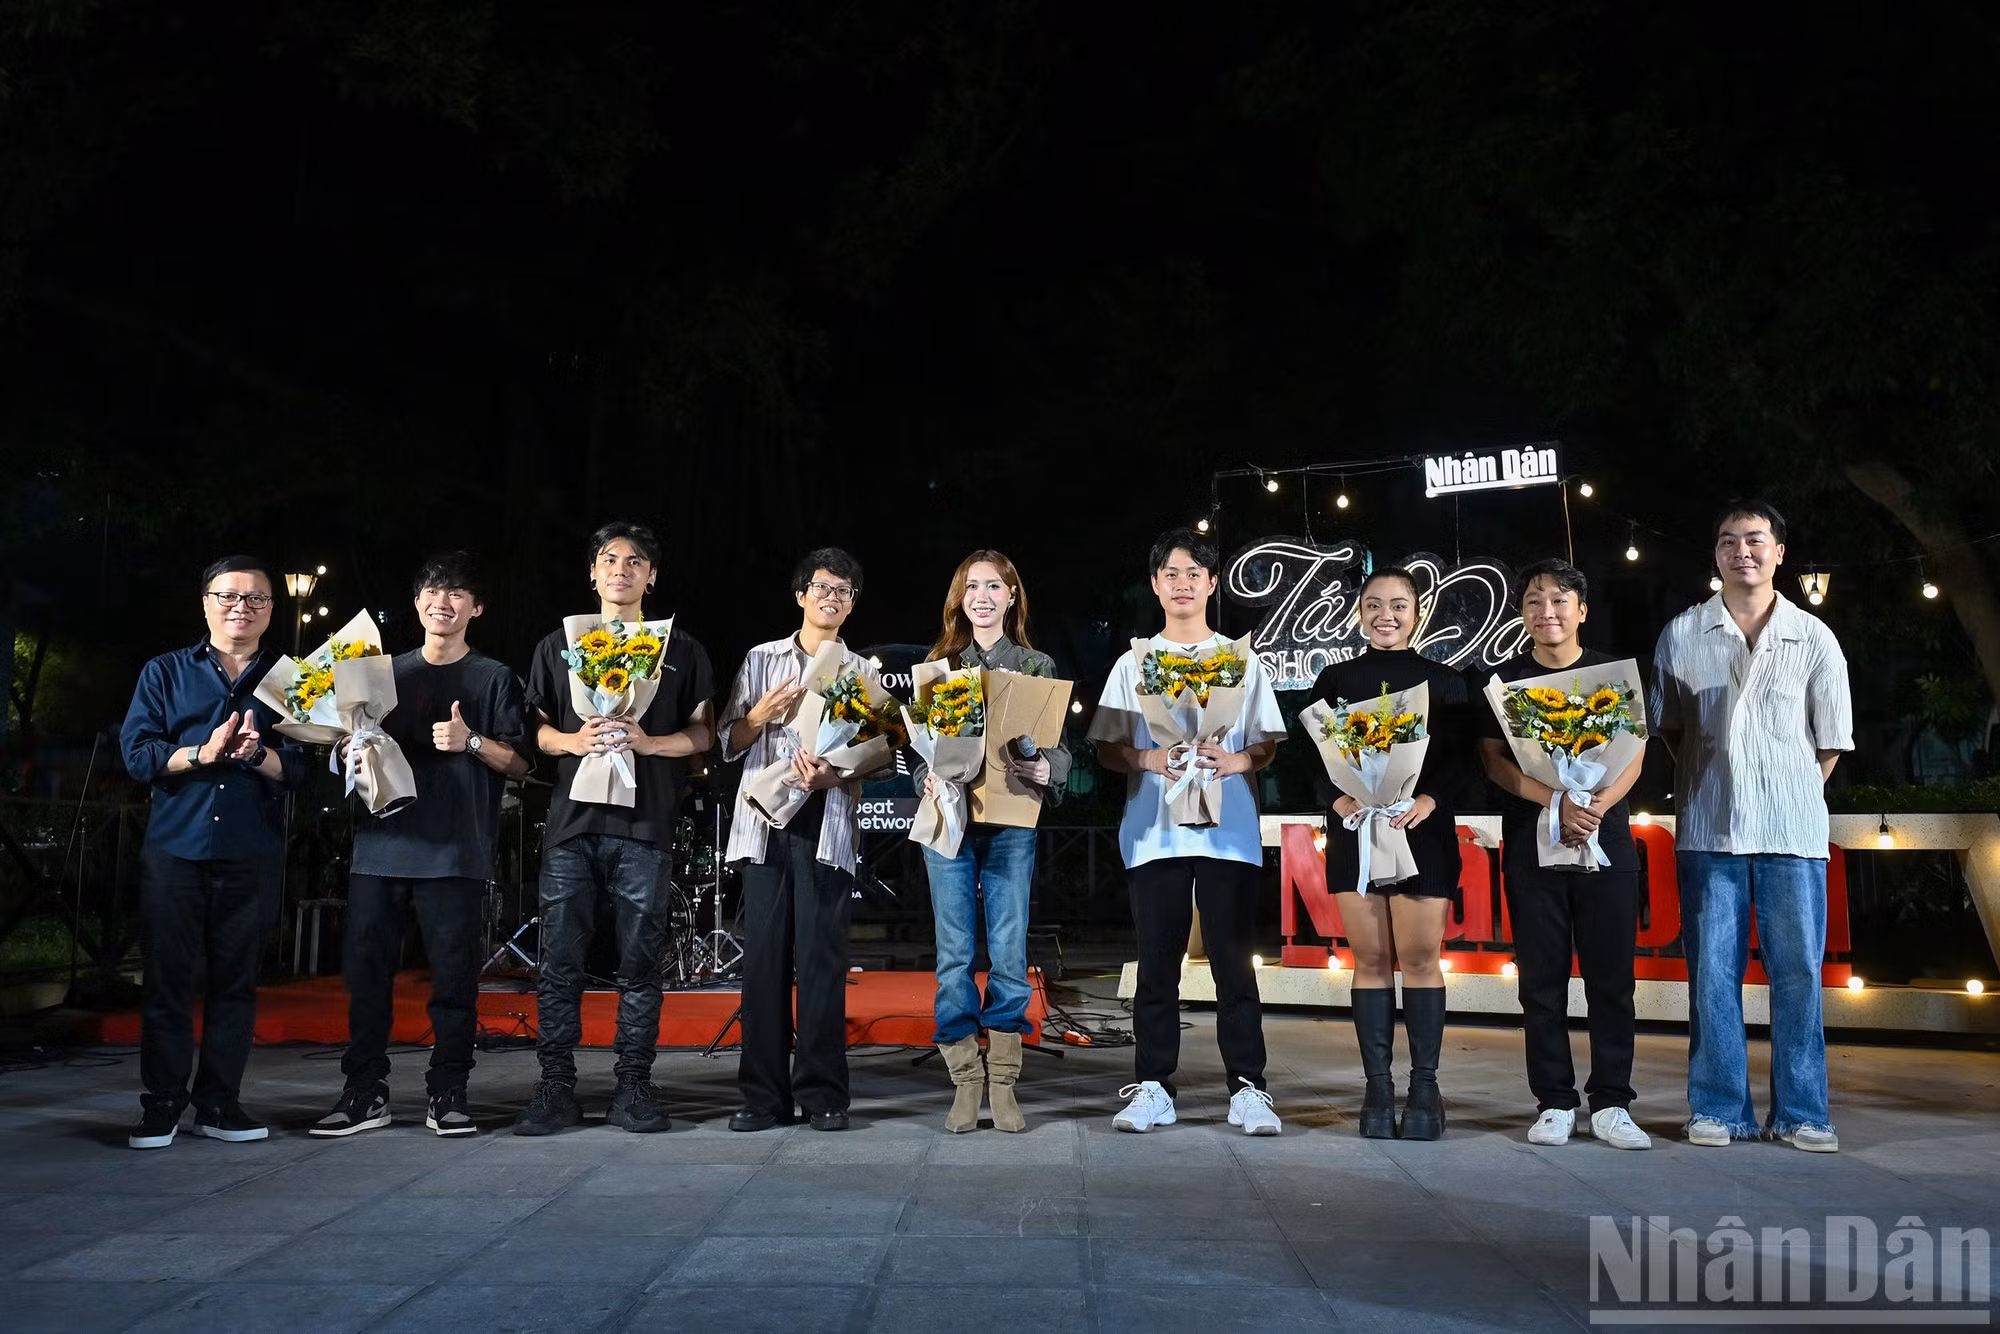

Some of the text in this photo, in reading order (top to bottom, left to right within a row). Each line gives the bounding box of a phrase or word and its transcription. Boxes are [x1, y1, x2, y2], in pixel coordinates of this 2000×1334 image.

[1425, 445, 1557, 489] Nhân Dân
[857, 815, 914, 830] etwor
